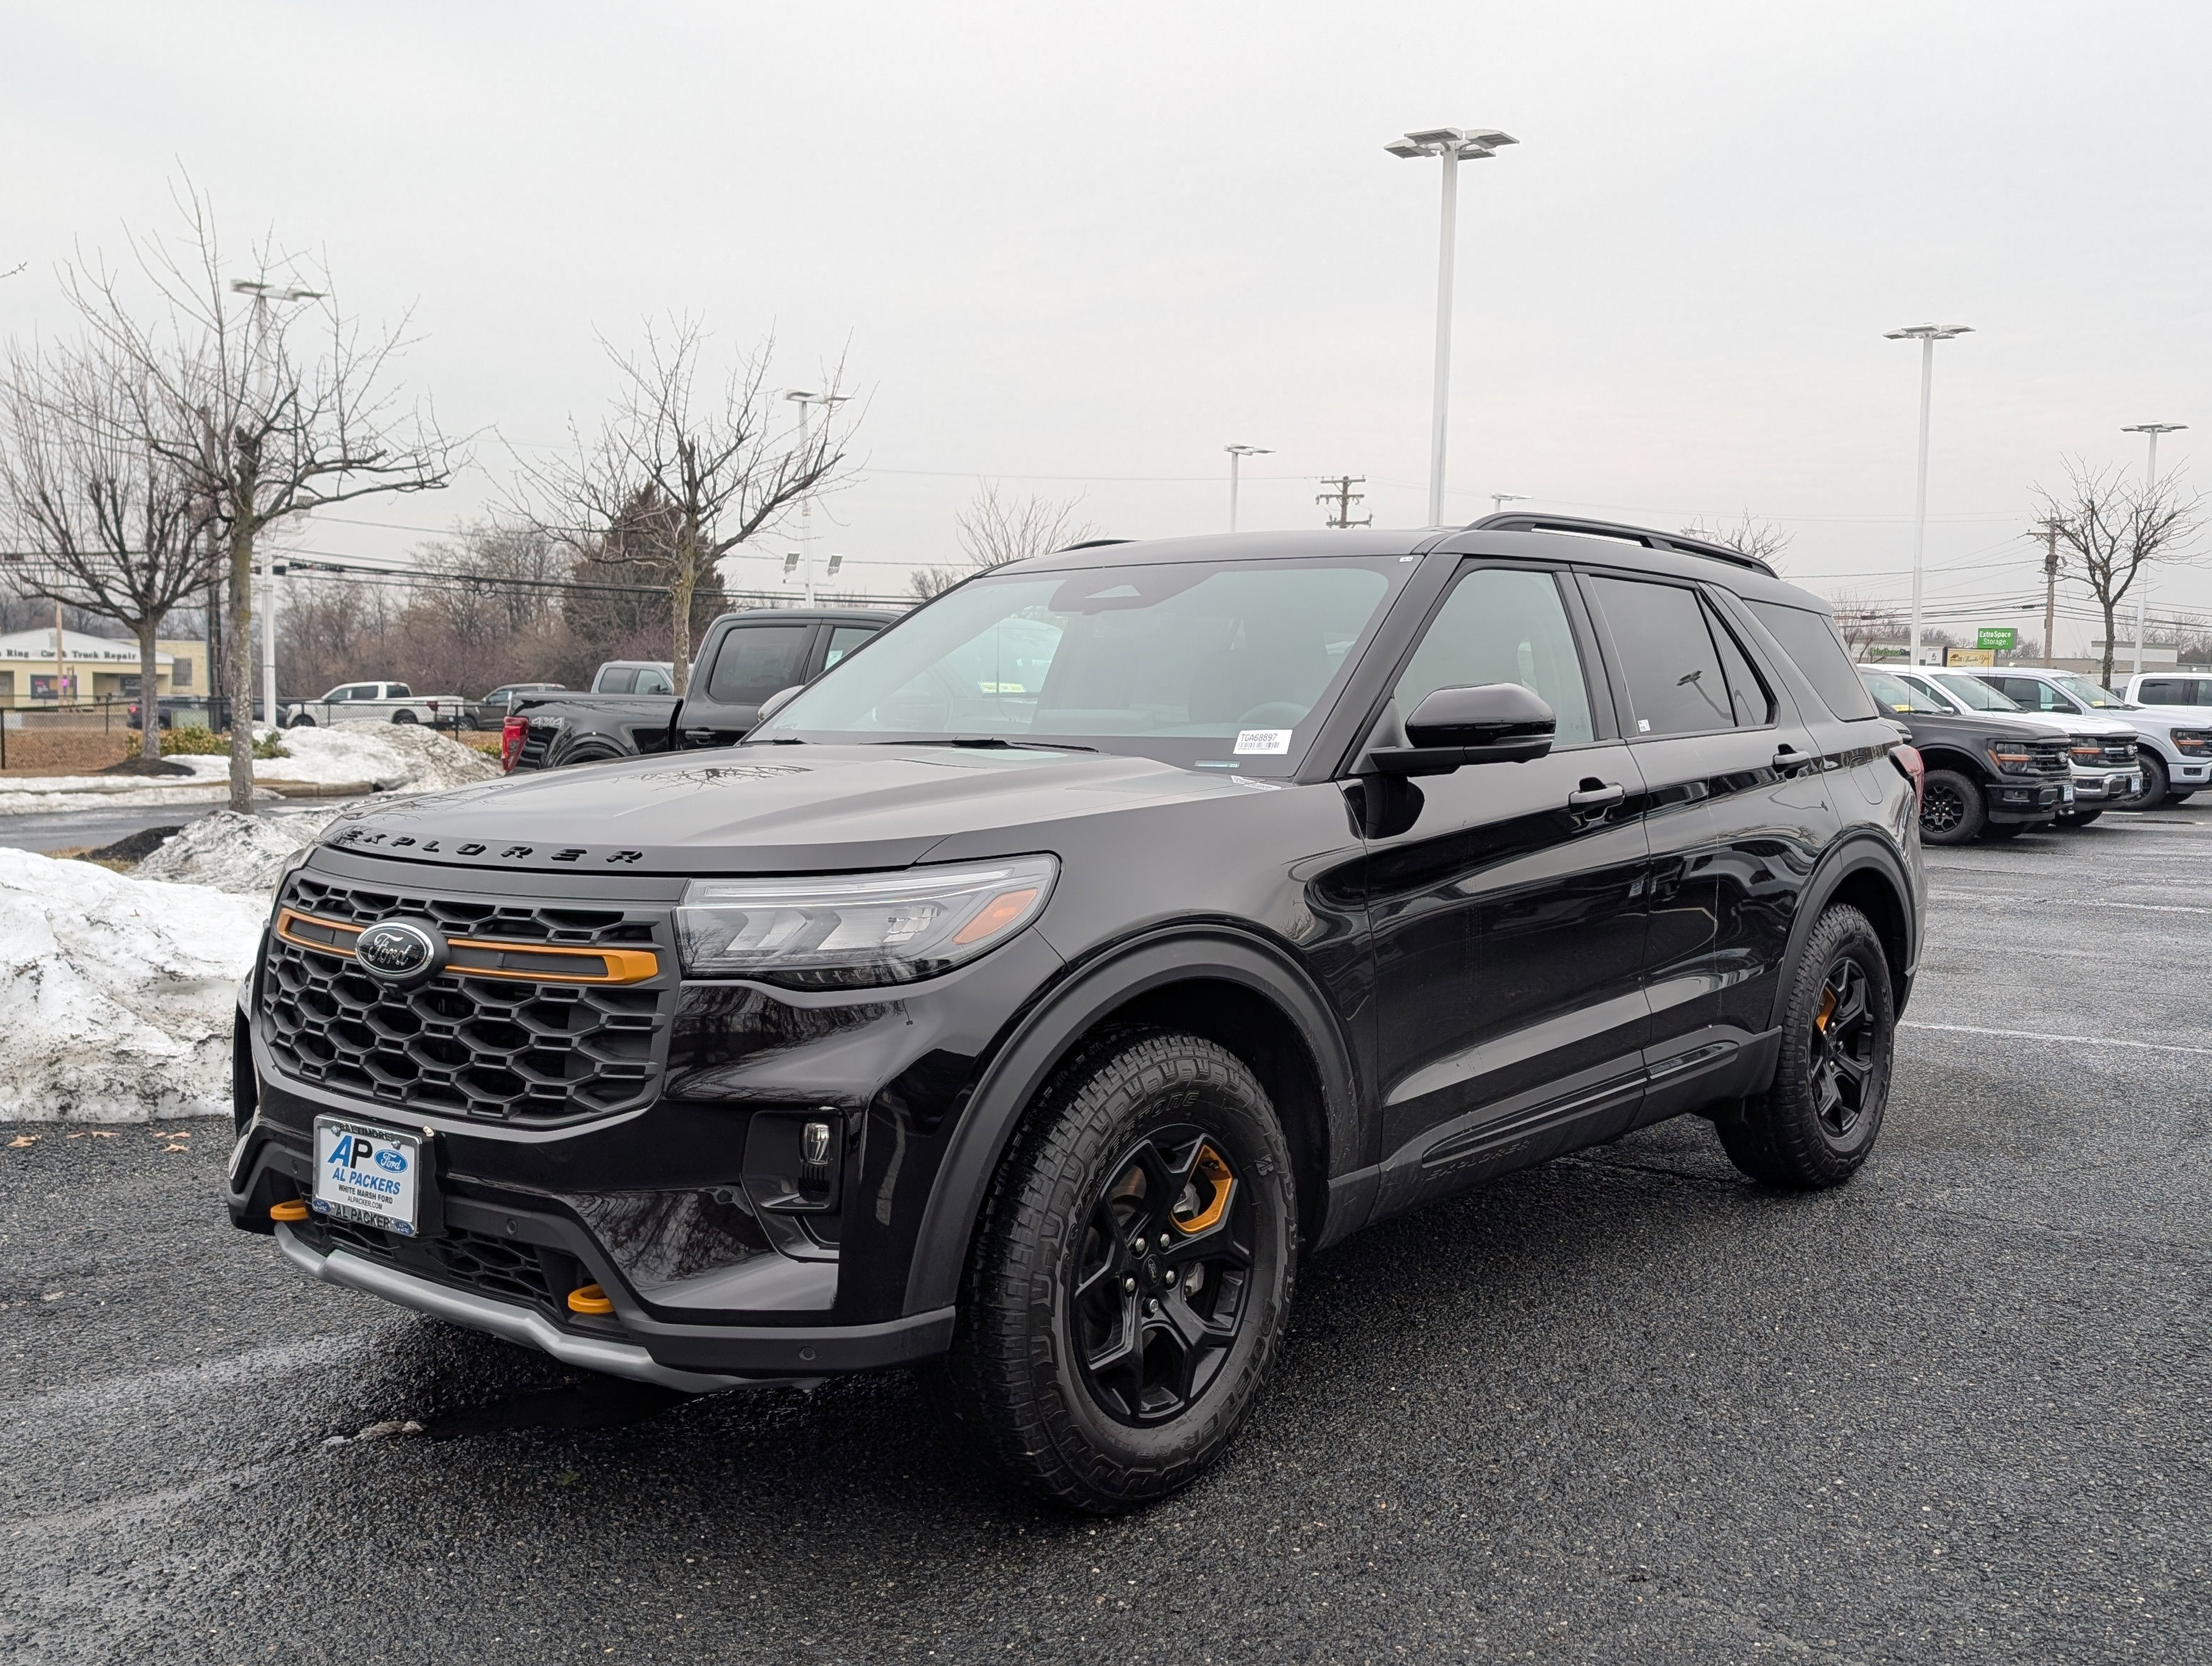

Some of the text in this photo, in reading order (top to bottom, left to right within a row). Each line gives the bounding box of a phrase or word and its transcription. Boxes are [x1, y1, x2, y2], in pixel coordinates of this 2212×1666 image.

[7, 649, 29, 658] Ring
[104, 651, 136, 662] Repair
[1241, 733, 1278, 741] TGA68897
[340, 830, 644, 864] EXPLORER
[368, 933, 412, 966] Ford
[339, 1123, 391, 1141] BALTIMORE
[327, 1135, 372, 1169] AP
[381, 1152, 401, 1170] Ford
[332, 1167, 401, 1195] AL PACKERS
[338, 1184, 393, 1204] WHITE MARSH FORD
[348, 1196, 383, 1210] ALPACKER.COM
[336, 1204, 390, 1229] AL PACKER
